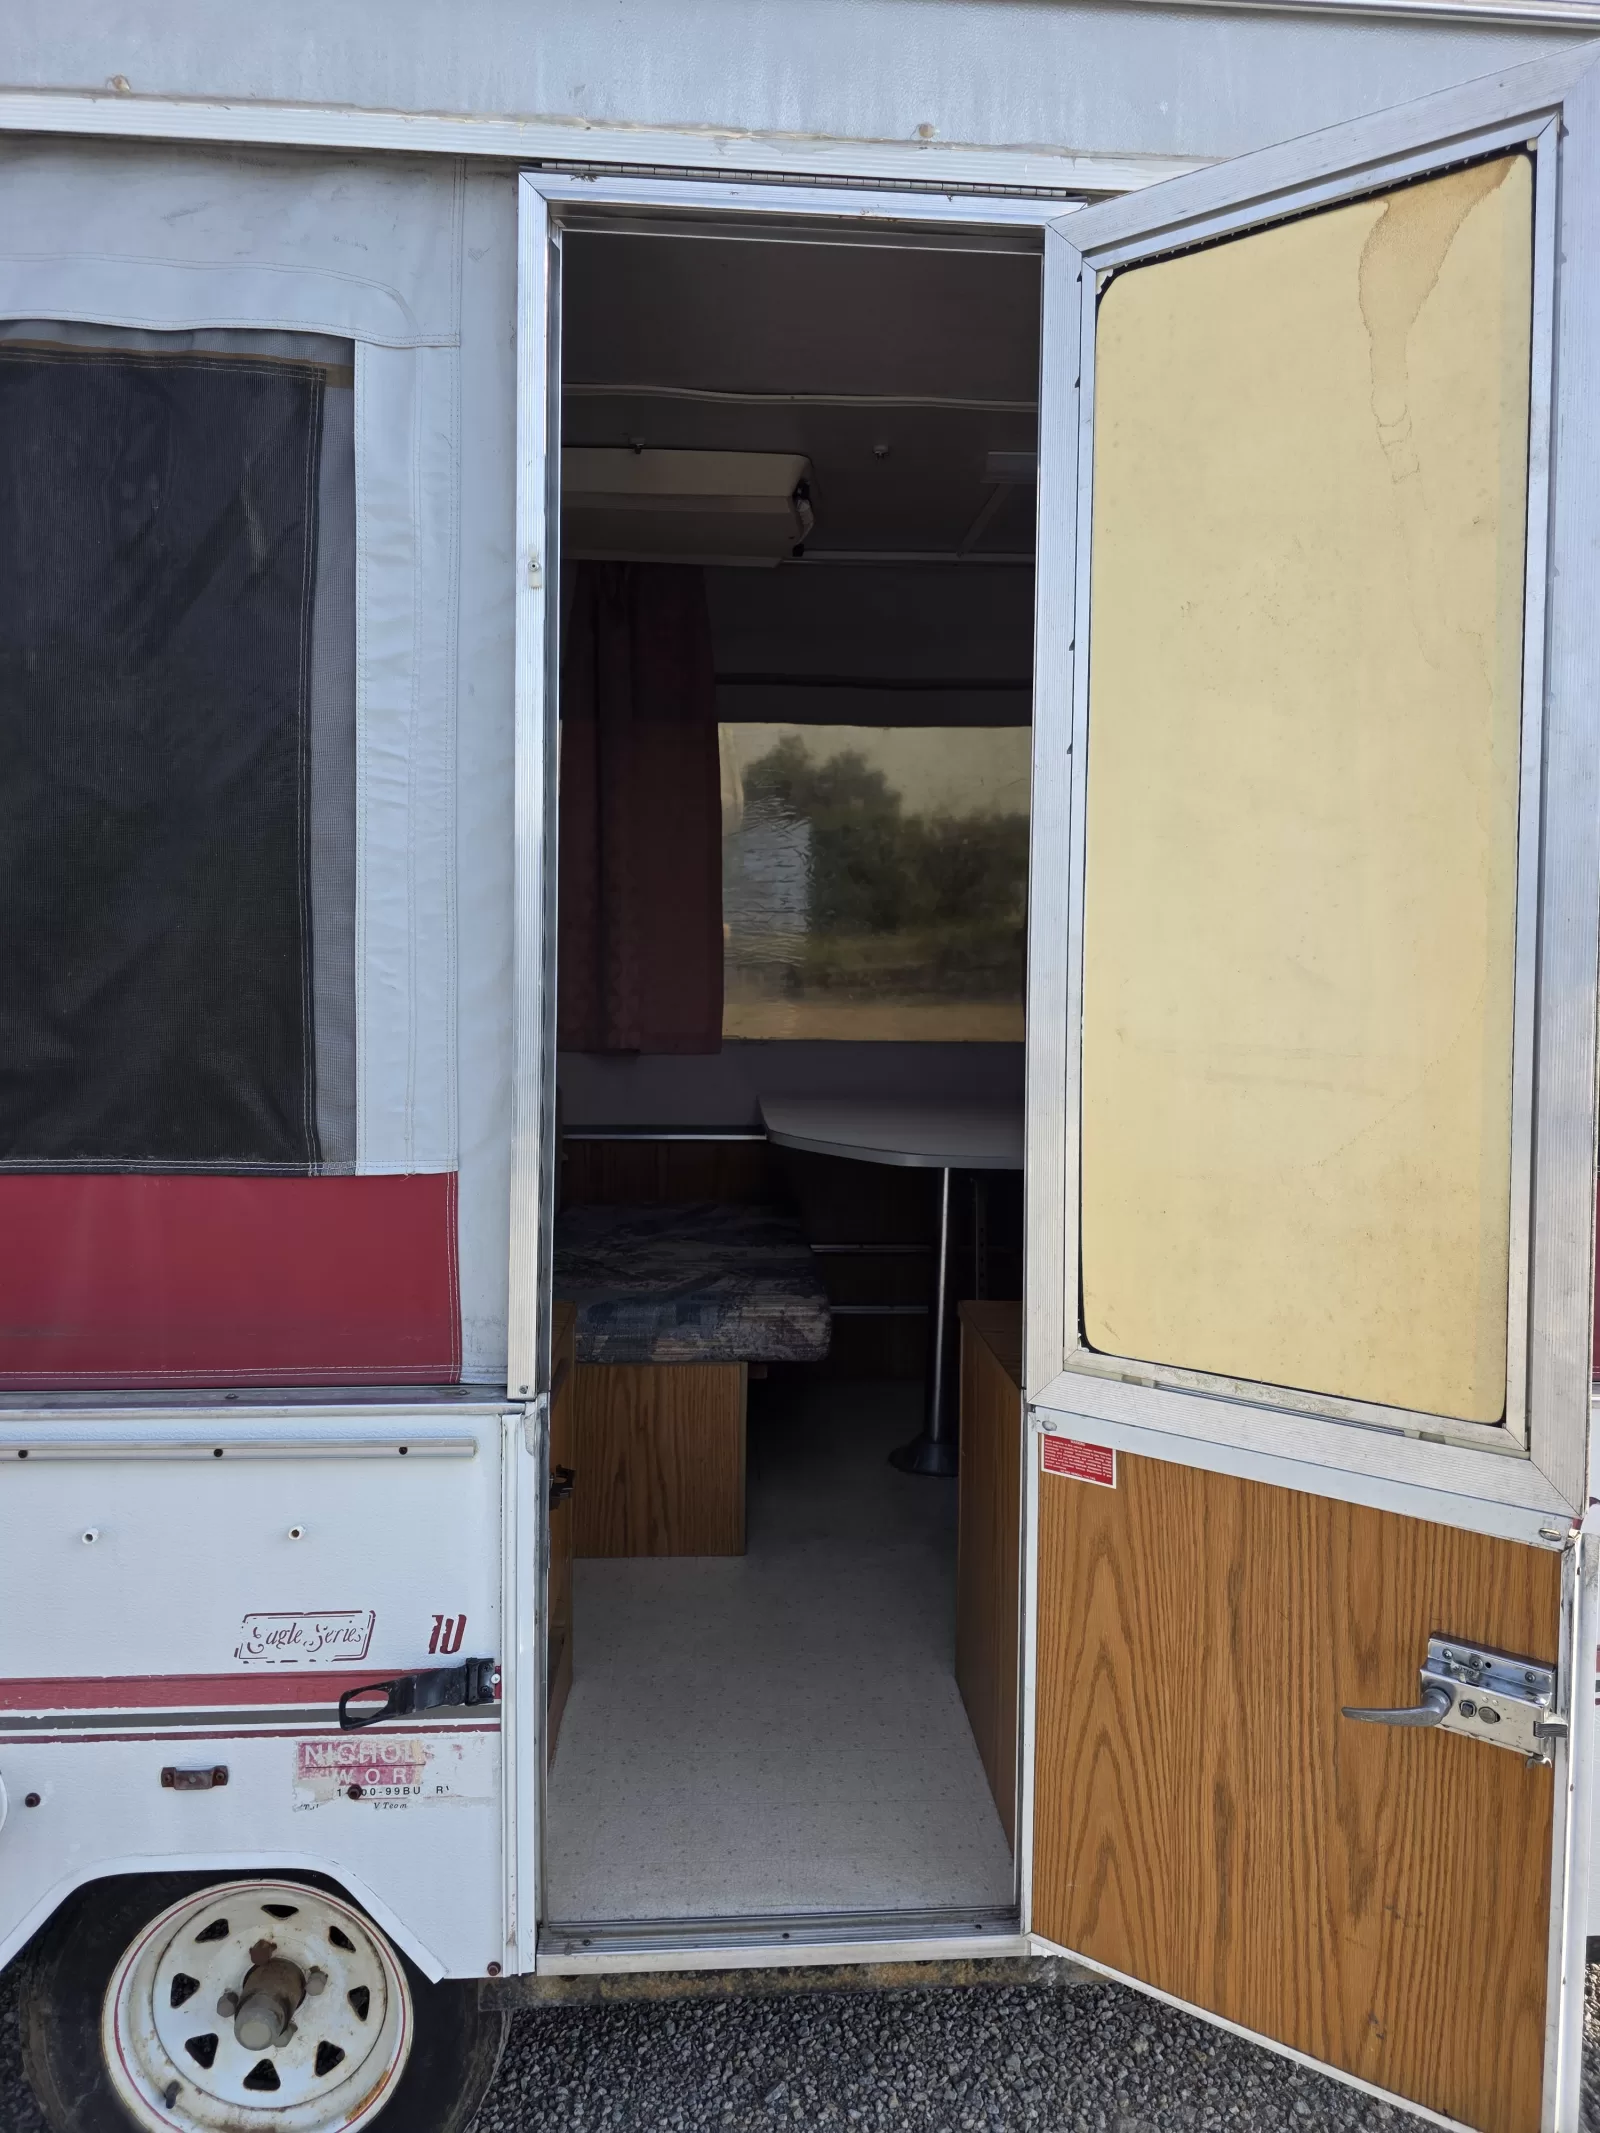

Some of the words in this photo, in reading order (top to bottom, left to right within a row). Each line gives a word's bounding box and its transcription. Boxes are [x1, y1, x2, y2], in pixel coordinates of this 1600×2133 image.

[247, 1622, 303, 1654] Eagle
[303, 1620, 364, 1652] Series
[428, 1614, 467, 1654] 10
